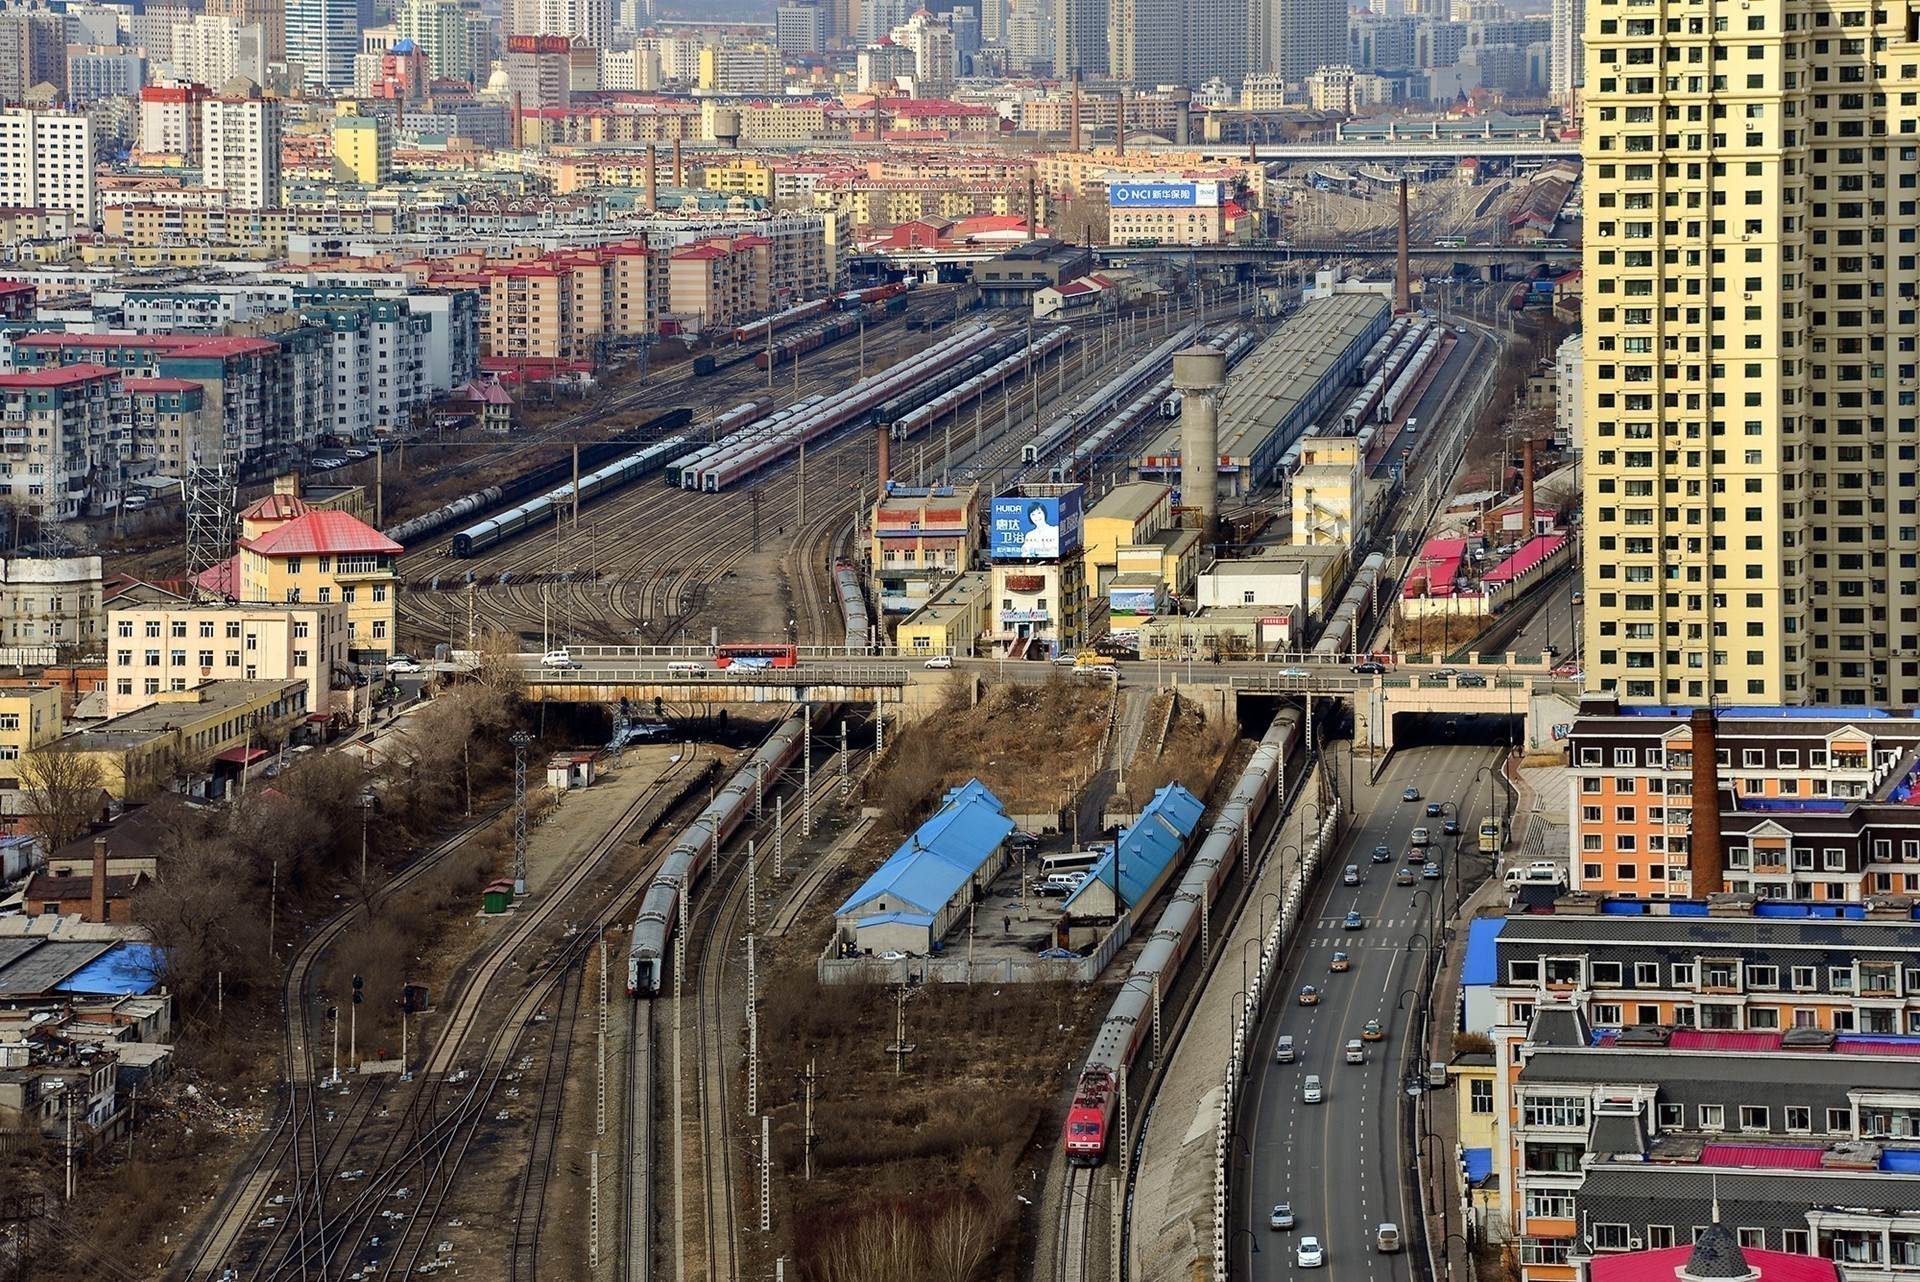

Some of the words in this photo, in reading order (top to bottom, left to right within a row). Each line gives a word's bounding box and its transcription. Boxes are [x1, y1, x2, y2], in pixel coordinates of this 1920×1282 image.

[1131, 189, 1151, 199] NCI
[1152, 189, 1190, 199] 新华保险
[996, 519, 1020, 530] 惠达
[1001, 532, 1024, 543] 卫浴
